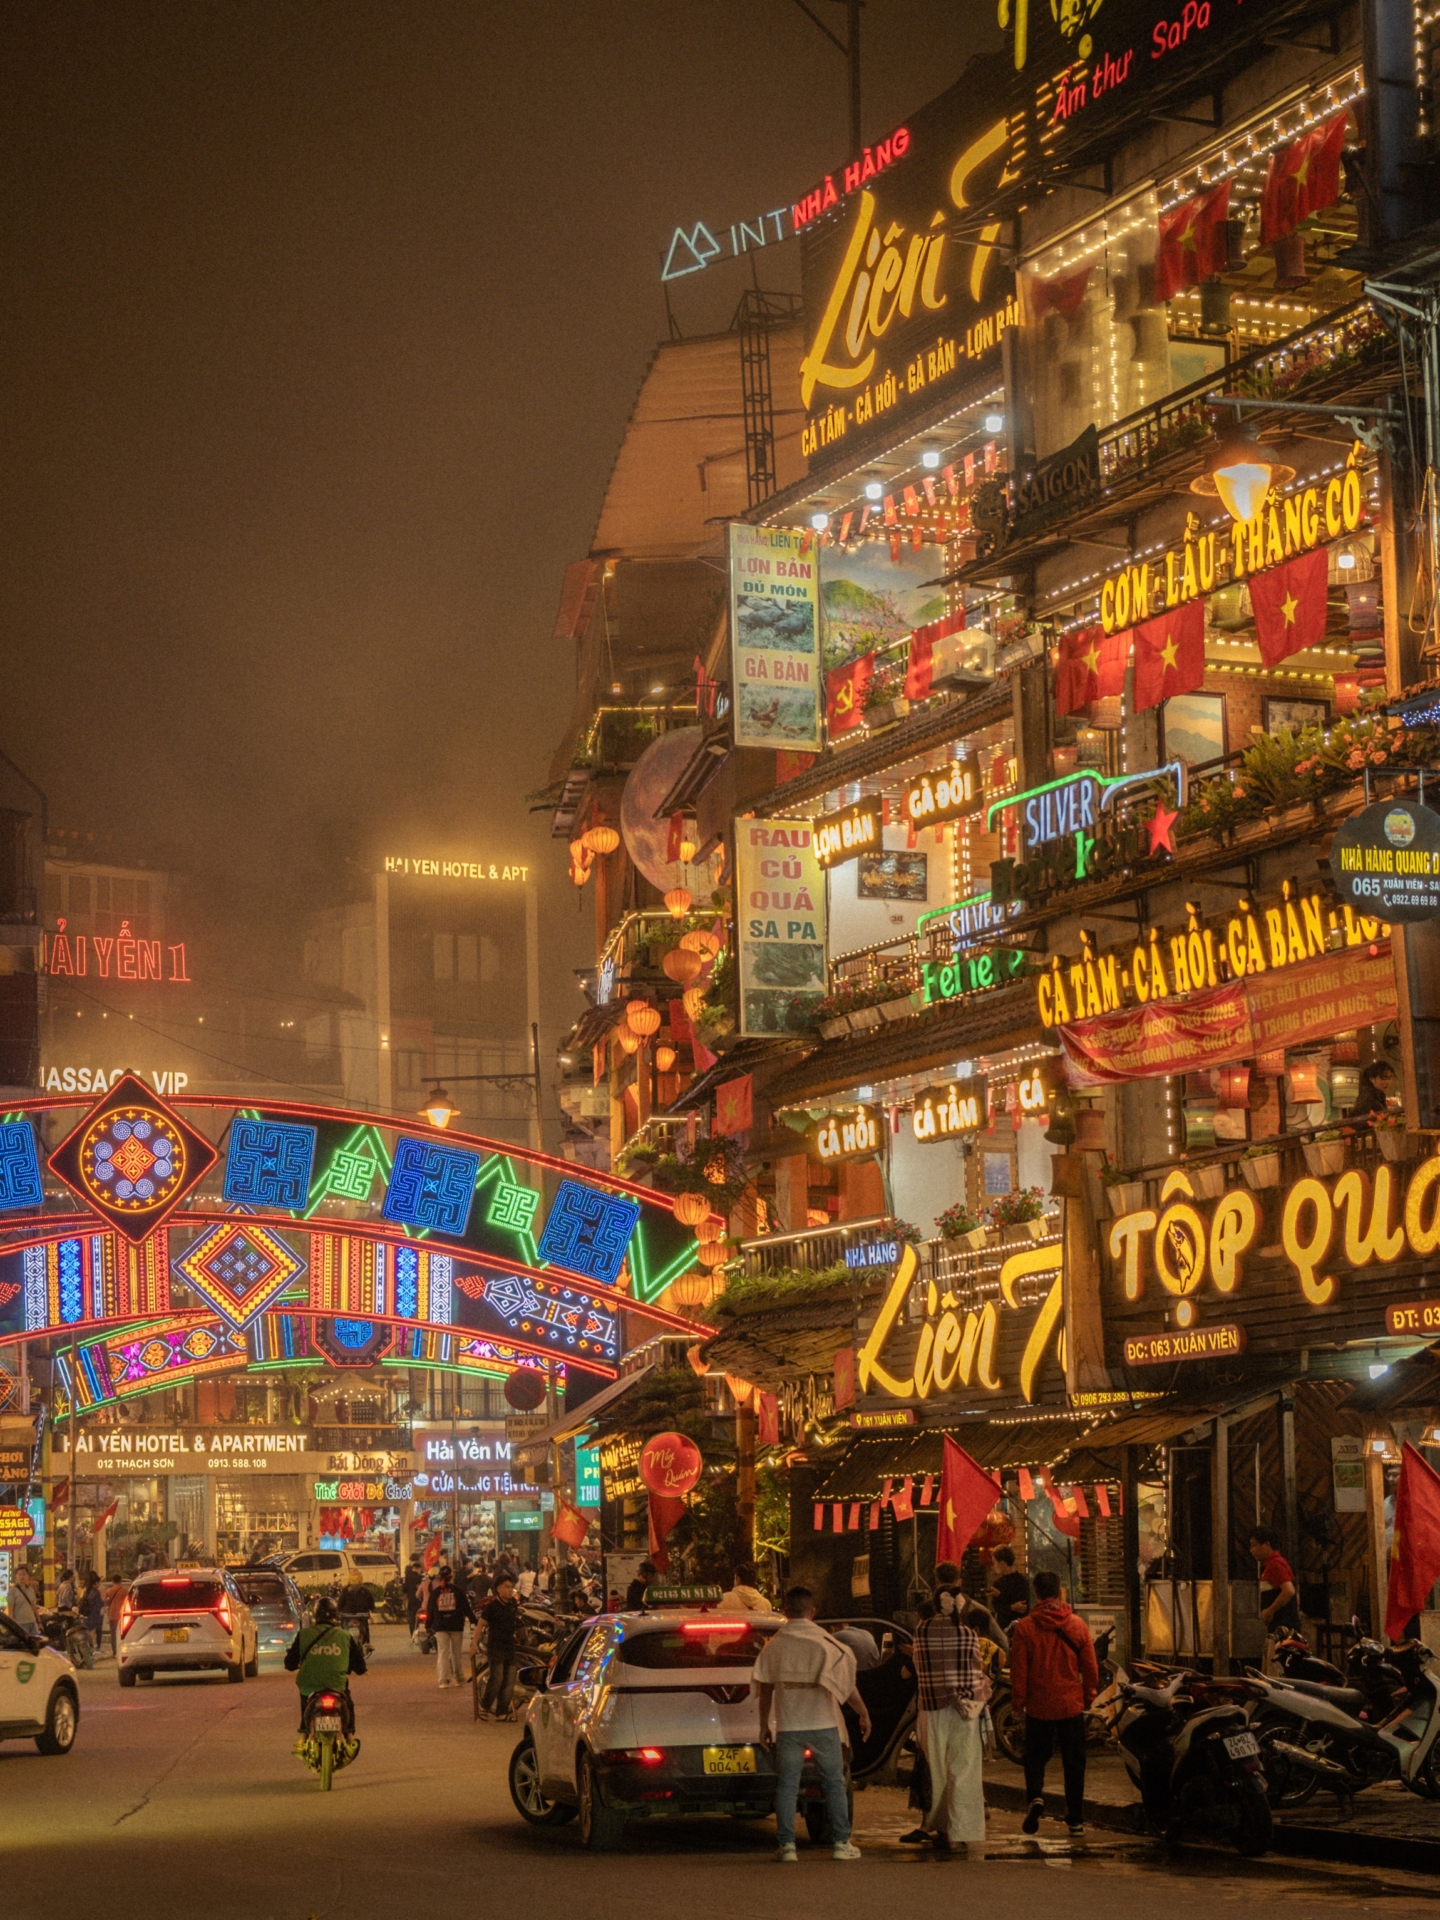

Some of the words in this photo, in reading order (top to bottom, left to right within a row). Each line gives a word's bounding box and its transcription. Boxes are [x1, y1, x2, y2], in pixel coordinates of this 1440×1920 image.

[793, 176, 838, 230] NHÀ
[844, 127, 910, 194] HÀNG
[800, 189, 947, 411] Liên
[801, 416, 818, 457] CÁ
[856, 385, 872, 424] CÁ
[875, 370, 897, 414] HỒI
[907, 352, 924, 394] GÀ
[737, 557, 770, 578] LỢN
[776, 557, 812, 580] BẢN
[743, 579, 765, 594] ĐỦ
[770, 584, 808, 598] MÓN
[745, 655, 768, 680] GÀ
[774, 655, 809, 683] BẢN
[909, 778, 934, 819] GÀ
[1025, 779, 1095, 847] SILVER
[749, 827, 811, 849] RAU
[842, 807, 874, 850] BẢN
[412, 859, 440, 876] YEN
[442, 861, 486, 879] HOTEL
[489, 864, 498, 880] &
[502, 866, 529, 882] APT
[759, 854, 803, 880] CỦ
[1341, 844, 1363, 871] NHÀ
[1365, 844, 1394, 873] HÀNG
[1395, 849, 1430, 876] QUANG
[749, 886, 815, 912] QUẢ
[1352, 877, 1381, 896] 065
[749, 920, 780, 939] SA
[787, 921, 817, 940] PA
[44, 917, 87, 977] ẢI
[93, 920, 163, 981] YẾN
[167, 942, 191, 982] 1
[1037, 955, 1070, 1028] CÁ
[1132, 927, 1168, 1003] CÁ
[1170, 902, 1218, 994] HỒI
[1227, 899, 1266, 978] GÀ
[39, 1066, 140, 1093] ASSA
[152, 1070, 189, 1096] VIP
[1018, 1068, 1045, 1110] CÁ
[818, 1119, 840, 1158] CÁ
[842, 1105, 876, 1152] HỒI
[913, 1098, 936, 1139] CÁ
[857, 1243, 1001, 1400] Liên
[1392, 1309, 1420, 1330] ĐT:
[1150, 1338, 1171, 1358] 063
[1172, 1332, 1207, 1355] XUÂN
[1208, 1327, 1238, 1351] VIÊN
[98, 1427, 132, 1453] YẾN
[136, 1434, 190, 1453] HOTEL
[194, 1434, 206, 1453] &
[210, 1434, 307, 1453] APARTMENT
[426, 1440, 454, 1461] Hải
[97, 1458, 114, 1469] 012
[115, 1458, 151, 1471] THẠCH
[152, 1457, 175, 1469] SƠN
[314, 1481, 340, 1500] Thế
[457, 1477, 491, 1492] HNG
[580, 1485, 599, 1502] THU
[680, 1588, 691, 1599] 81
[694, 1588, 705, 1598] 81
[707, 1587, 718, 1598] 81
[310, 1643, 342, 1656] Grab
[709, 1762, 750, 1773] 004.14
[718, 1749, 740, 1760] 24F
